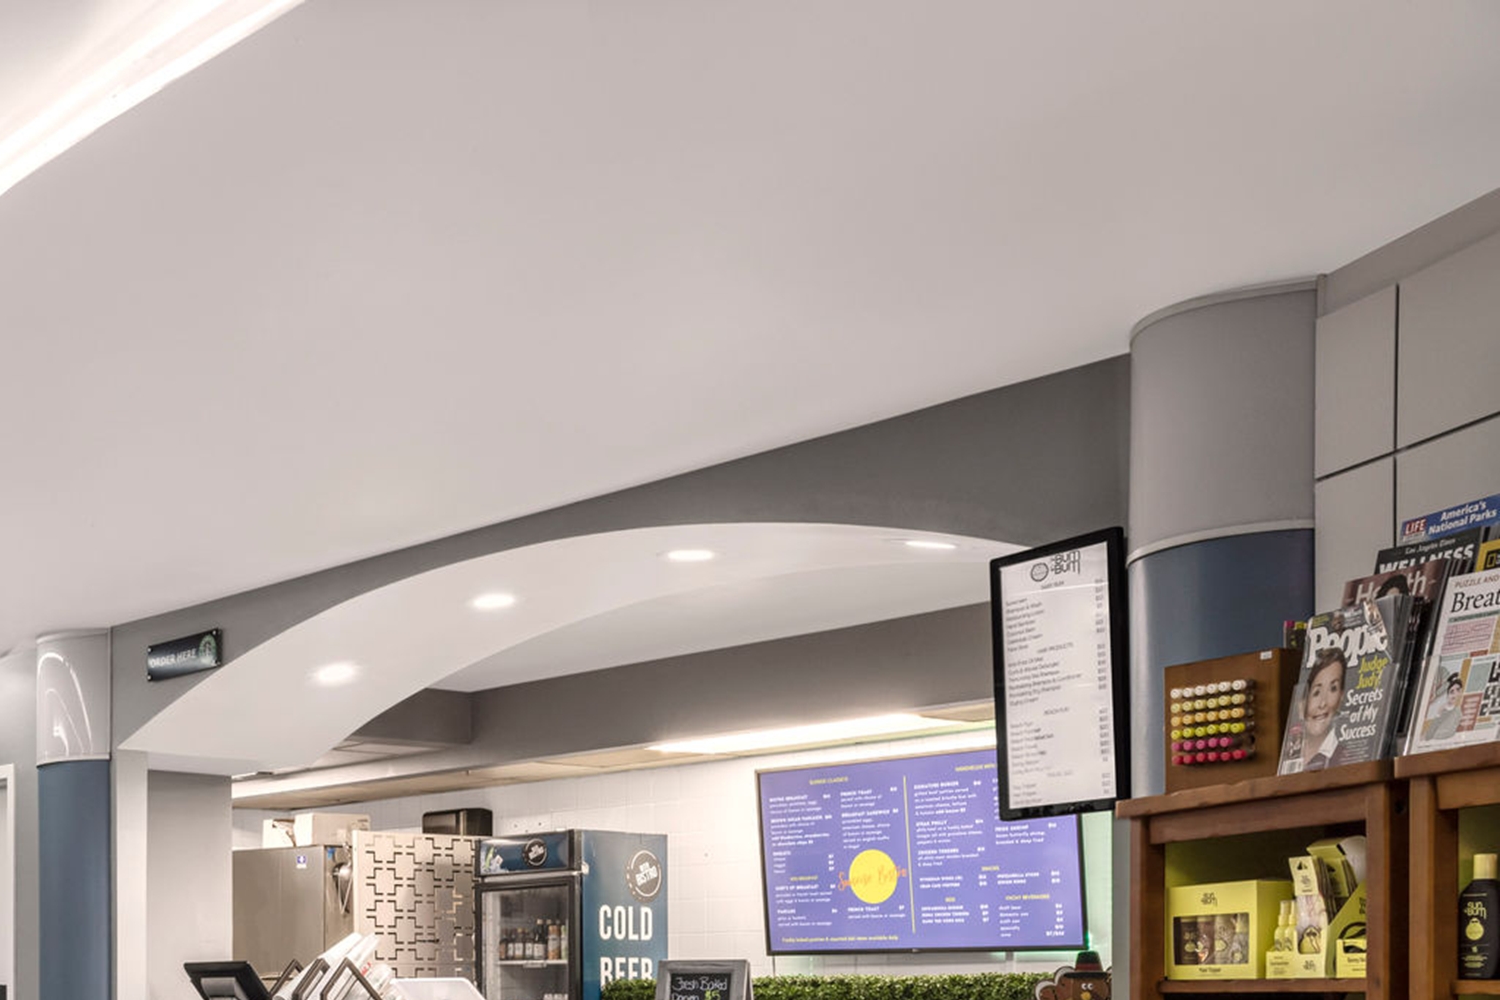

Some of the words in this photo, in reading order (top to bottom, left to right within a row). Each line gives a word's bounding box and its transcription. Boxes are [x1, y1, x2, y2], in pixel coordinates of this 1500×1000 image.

[1440, 501, 1486, 521] America's
[1404, 518, 1426, 534] LIFE
[1428, 515, 1468, 535] National
[1469, 508, 1498, 523] Parks
[148, 653, 176, 668] ORDER
[176, 647, 197, 663] HERE
[1359, 654, 1388, 673] Judge
[1345, 688, 1383, 707] Secrets
[1350, 709, 1361, 723] of
[1361, 704, 1379, 723] My
[1338, 723, 1377, 742] Success
[599, 904, 653, 941] COLD
